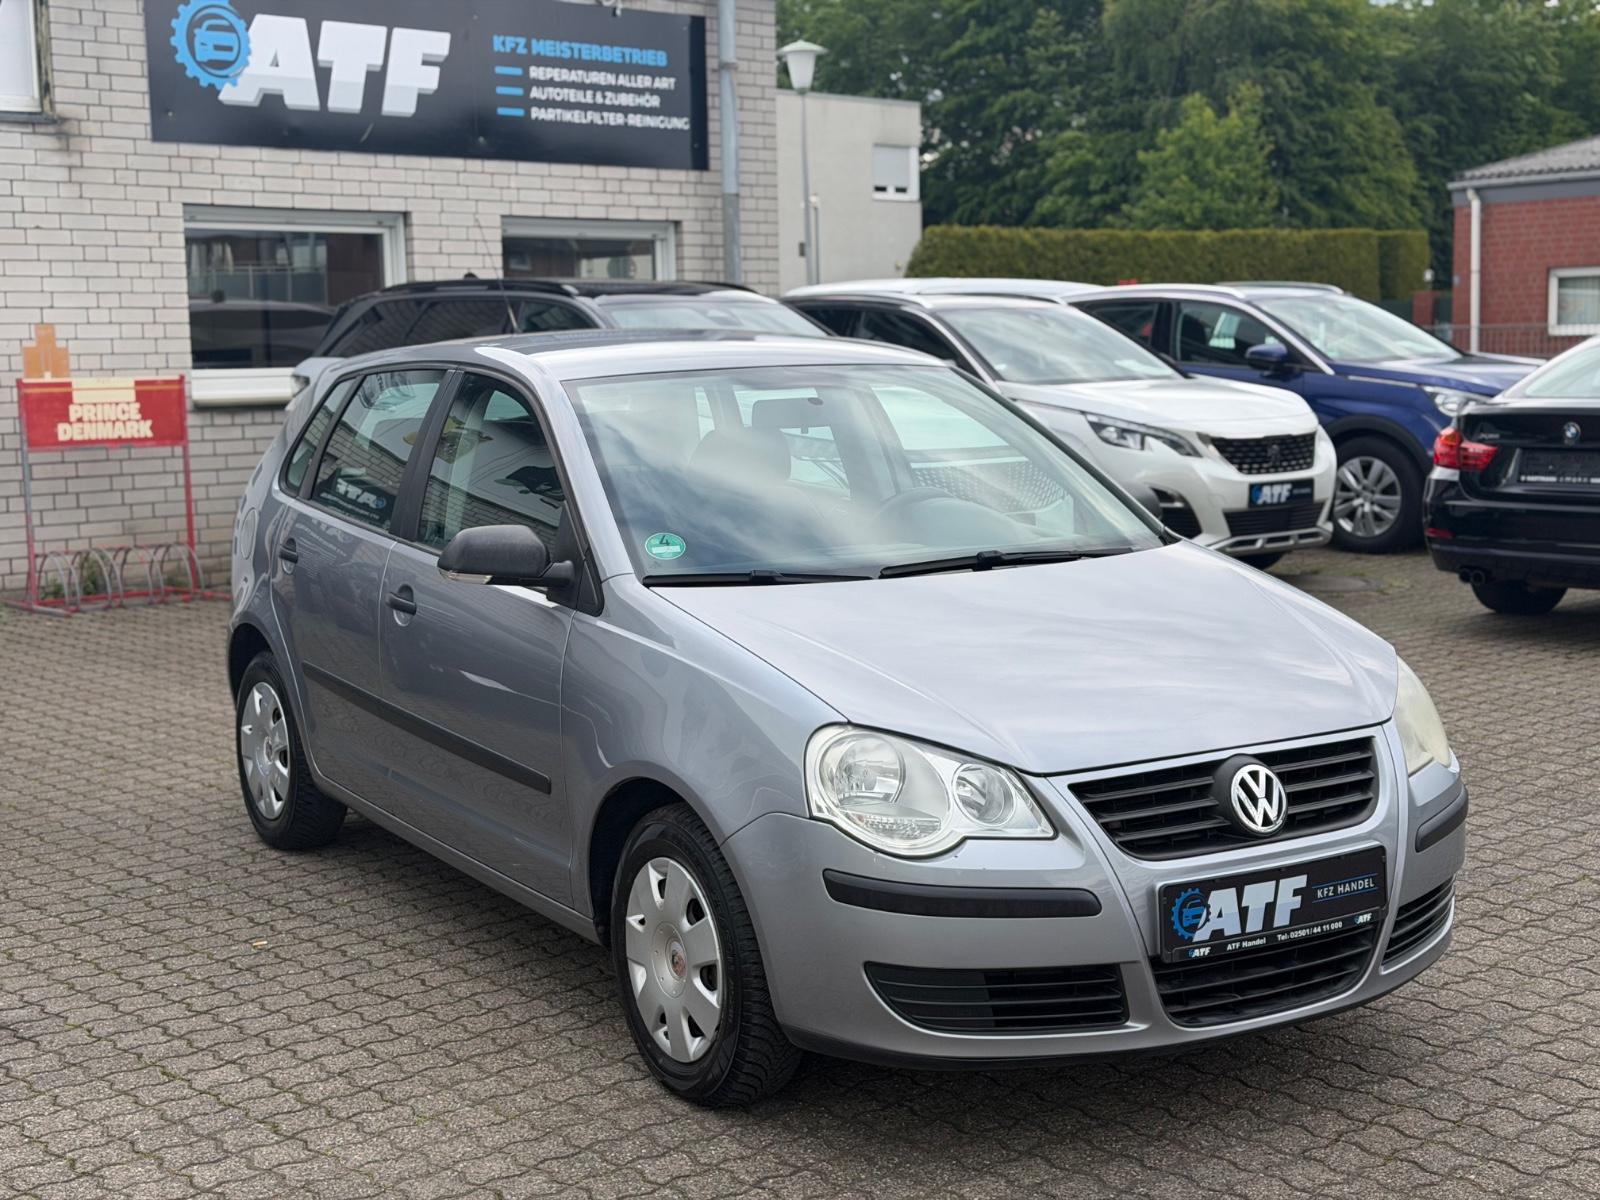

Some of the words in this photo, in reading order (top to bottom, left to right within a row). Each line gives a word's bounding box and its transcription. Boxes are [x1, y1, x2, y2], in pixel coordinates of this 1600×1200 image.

[493, 35, 528, 55] KFZ
[531, 38, 669, 67] MEISTERBETRIEB
[218, 13, 451, 118] ATF
[529, 66, 616, 86] REPERATUREN
[617, 73, 652, 89] ALLER
[653, 75, 677, 90] ART
[529, 86, 594, 104] AUTOTEILE
[595, 91, 603, 104] &
[604, 92, 661, 108] ZUBEHÖR
[531, 106, 691, 130] PARTIKELFILTER-REINIGUNG
[69, 402, 142, 422] PRINCE
[57, 420, 153, 442] DENMARK
[1257, 484, 1292, 504] ATF
[659, 535, 671, 546] 4
[1317, 887, 1334, 899] KFZ
[1337, 879, 1375, 895] HANDEL
[1193, 874, 1308, 942] ATF
[1357, 913, 1373, 924] ATF
[1192, 947, 1212, 958] ATF
[1226, 942, 1240, 951] ATF
[1241, 937, 1267, 949] Handel
